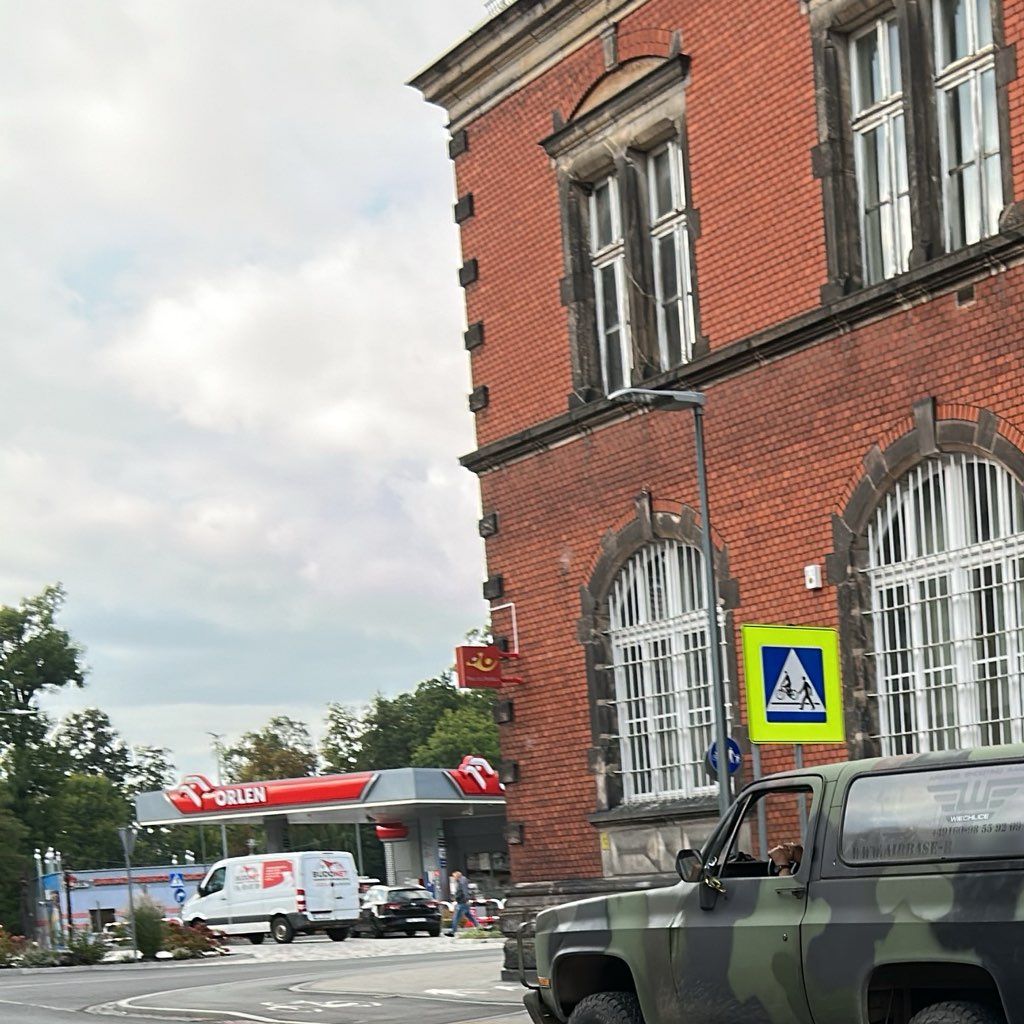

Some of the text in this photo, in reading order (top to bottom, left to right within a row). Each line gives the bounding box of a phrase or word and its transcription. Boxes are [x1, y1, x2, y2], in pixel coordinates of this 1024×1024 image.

[215, 787, 267, 807] ORLEN
[950, 813, 989, 822] WIECHLICE
[981, 823, 993, 833] 55
[995, 822, 1007, 833] 92
